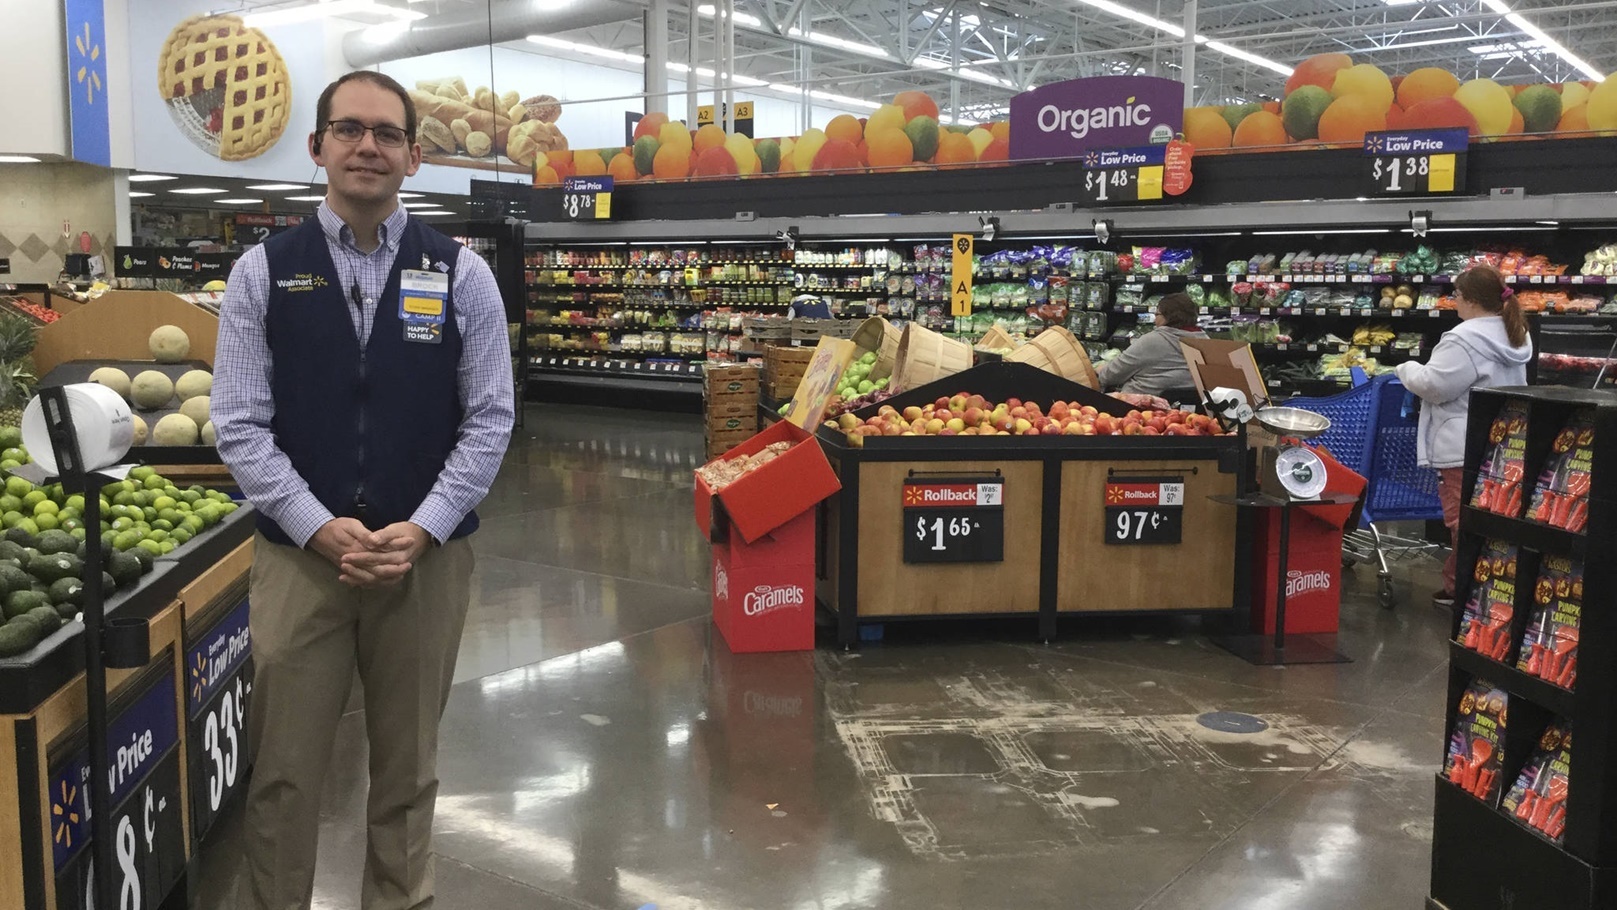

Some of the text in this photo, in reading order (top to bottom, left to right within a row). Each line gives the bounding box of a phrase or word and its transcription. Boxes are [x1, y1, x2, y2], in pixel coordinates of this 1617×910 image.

[697, 110, 709, 120] A2
[736, 106, 749, 117] A3
[1037, 97, 1151, 139] Organic
[1385, 139, 1444, 152] Low Price
[1101, 153, 1147, 165] Low Price
[574, 182, 602, 191] Low Price
[276, 278, 313, 288] Walmart
[956, 280, 968, 295] A
[960, 299, 965, 313] 1
[924, 488, 977, 501] Rollback
[1124, 490, 1157, 499] Rollback
[1285, 570, 1331, 596] aramels
[744, 585, 804, 616] Caramels
[208, 626, 250, 687] Low Price
[117, 729, 153, 785] Price
